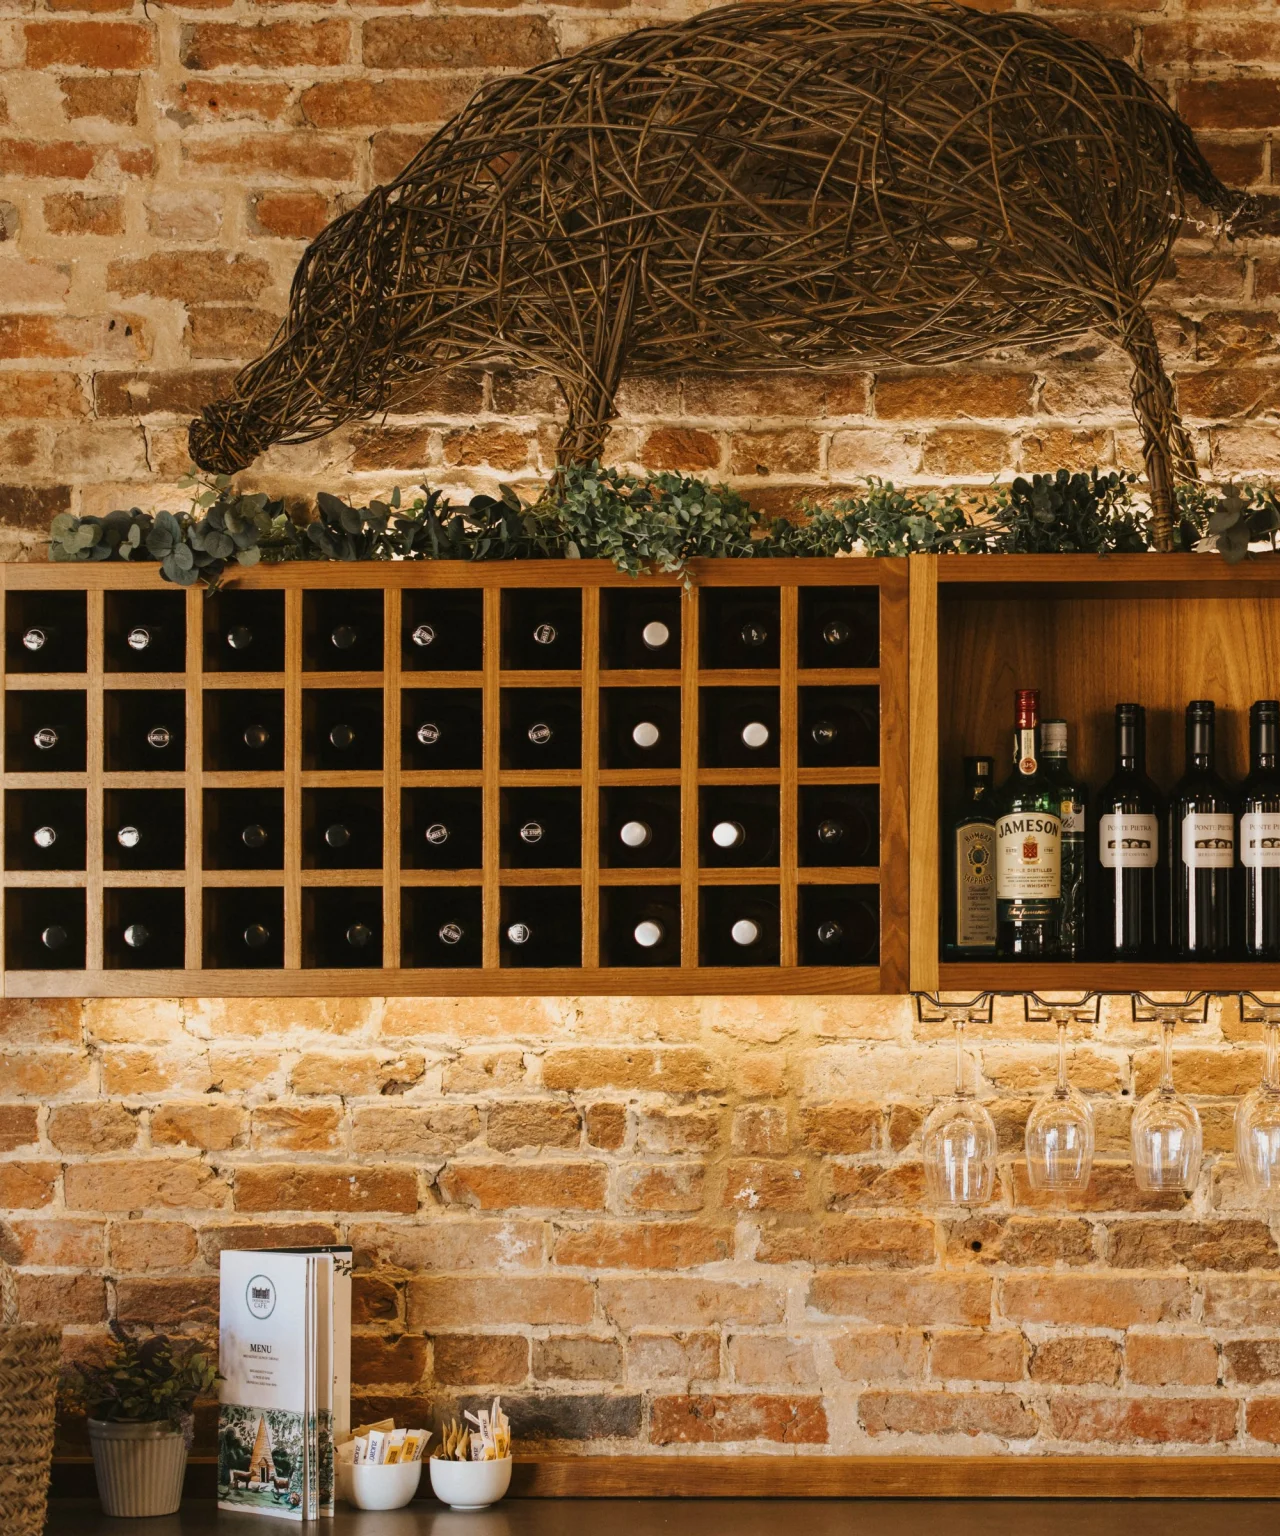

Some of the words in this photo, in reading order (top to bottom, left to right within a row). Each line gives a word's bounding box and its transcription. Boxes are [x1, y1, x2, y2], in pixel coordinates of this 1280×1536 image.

[999, 820, 1058, 838] JAMESON
[964, 832, 992, 843] BOMBAY
[963, 873, 993, 884] SAPPHIRE
[250, 1344, 272, 1353] MENU
